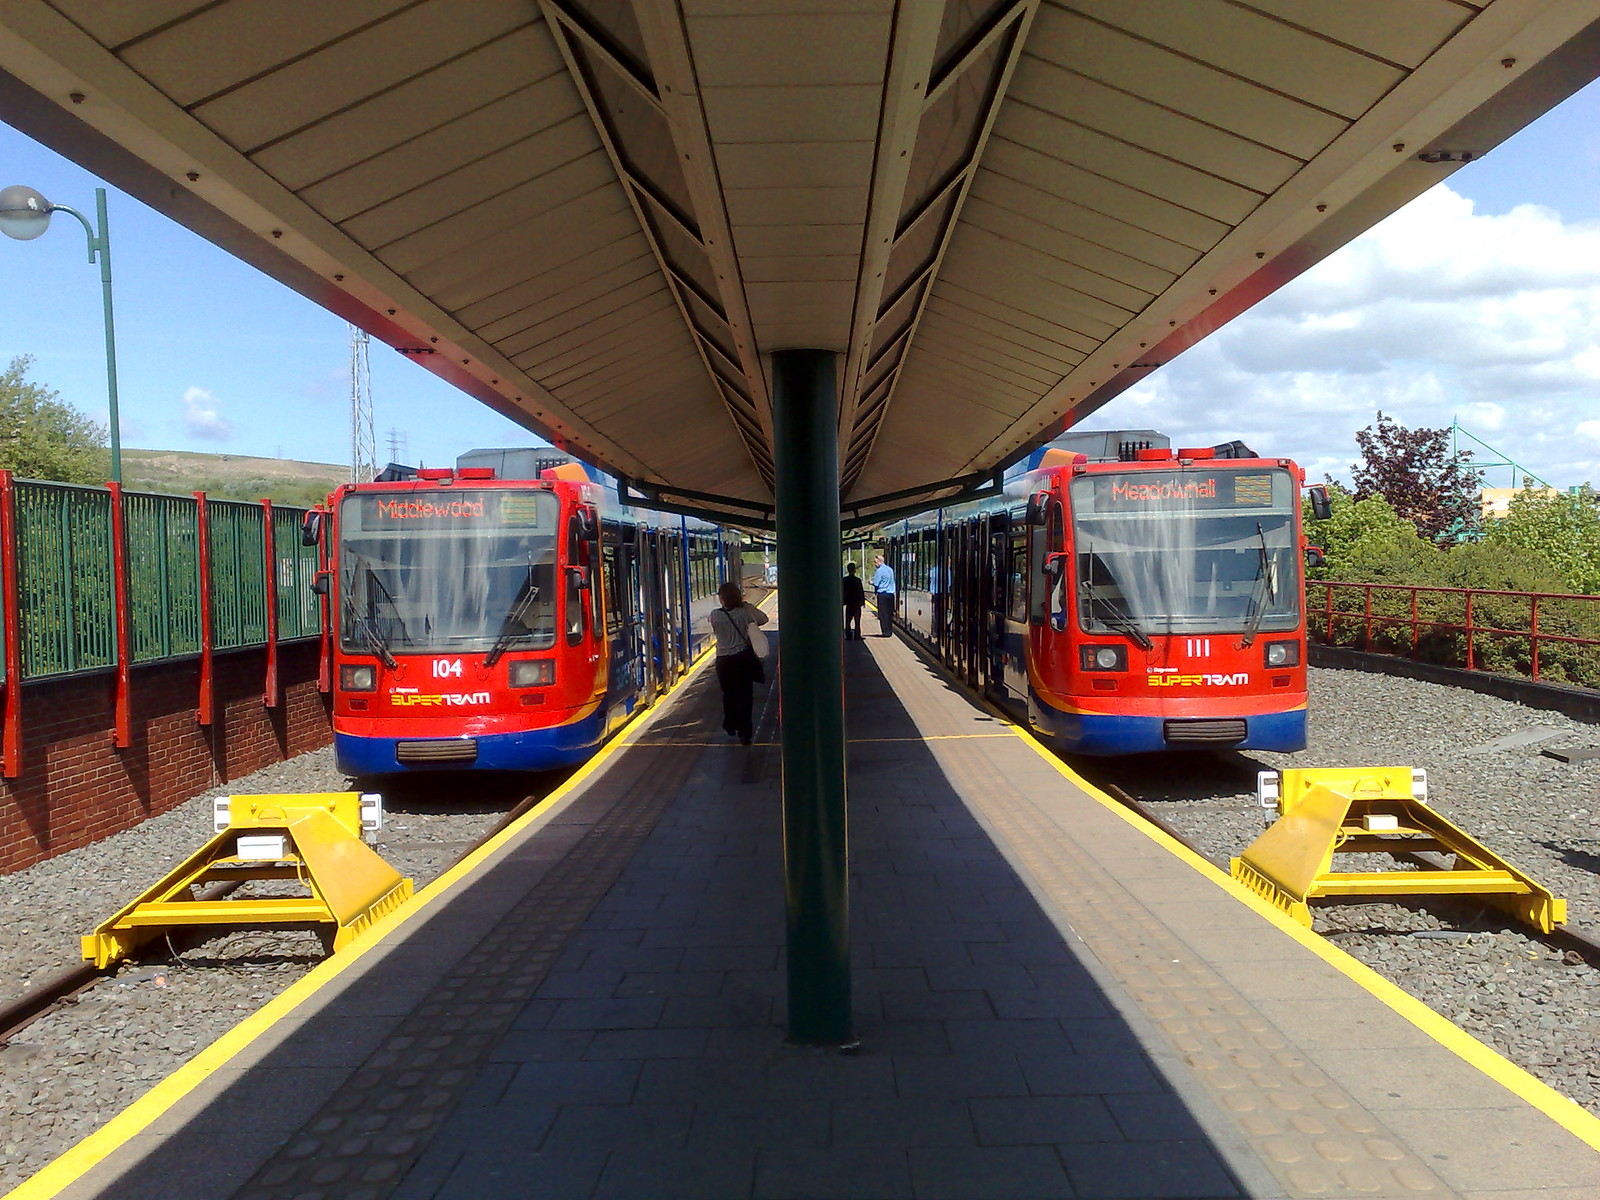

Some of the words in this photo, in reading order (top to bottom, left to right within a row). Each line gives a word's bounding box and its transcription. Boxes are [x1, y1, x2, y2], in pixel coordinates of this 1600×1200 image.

[1112, 478, 1217, 501] Meadowhall
[377, 497, 485, 519] Middlewood
[1187, 638, 1210, 657] 111
[432, 658, 463, 678] 104
